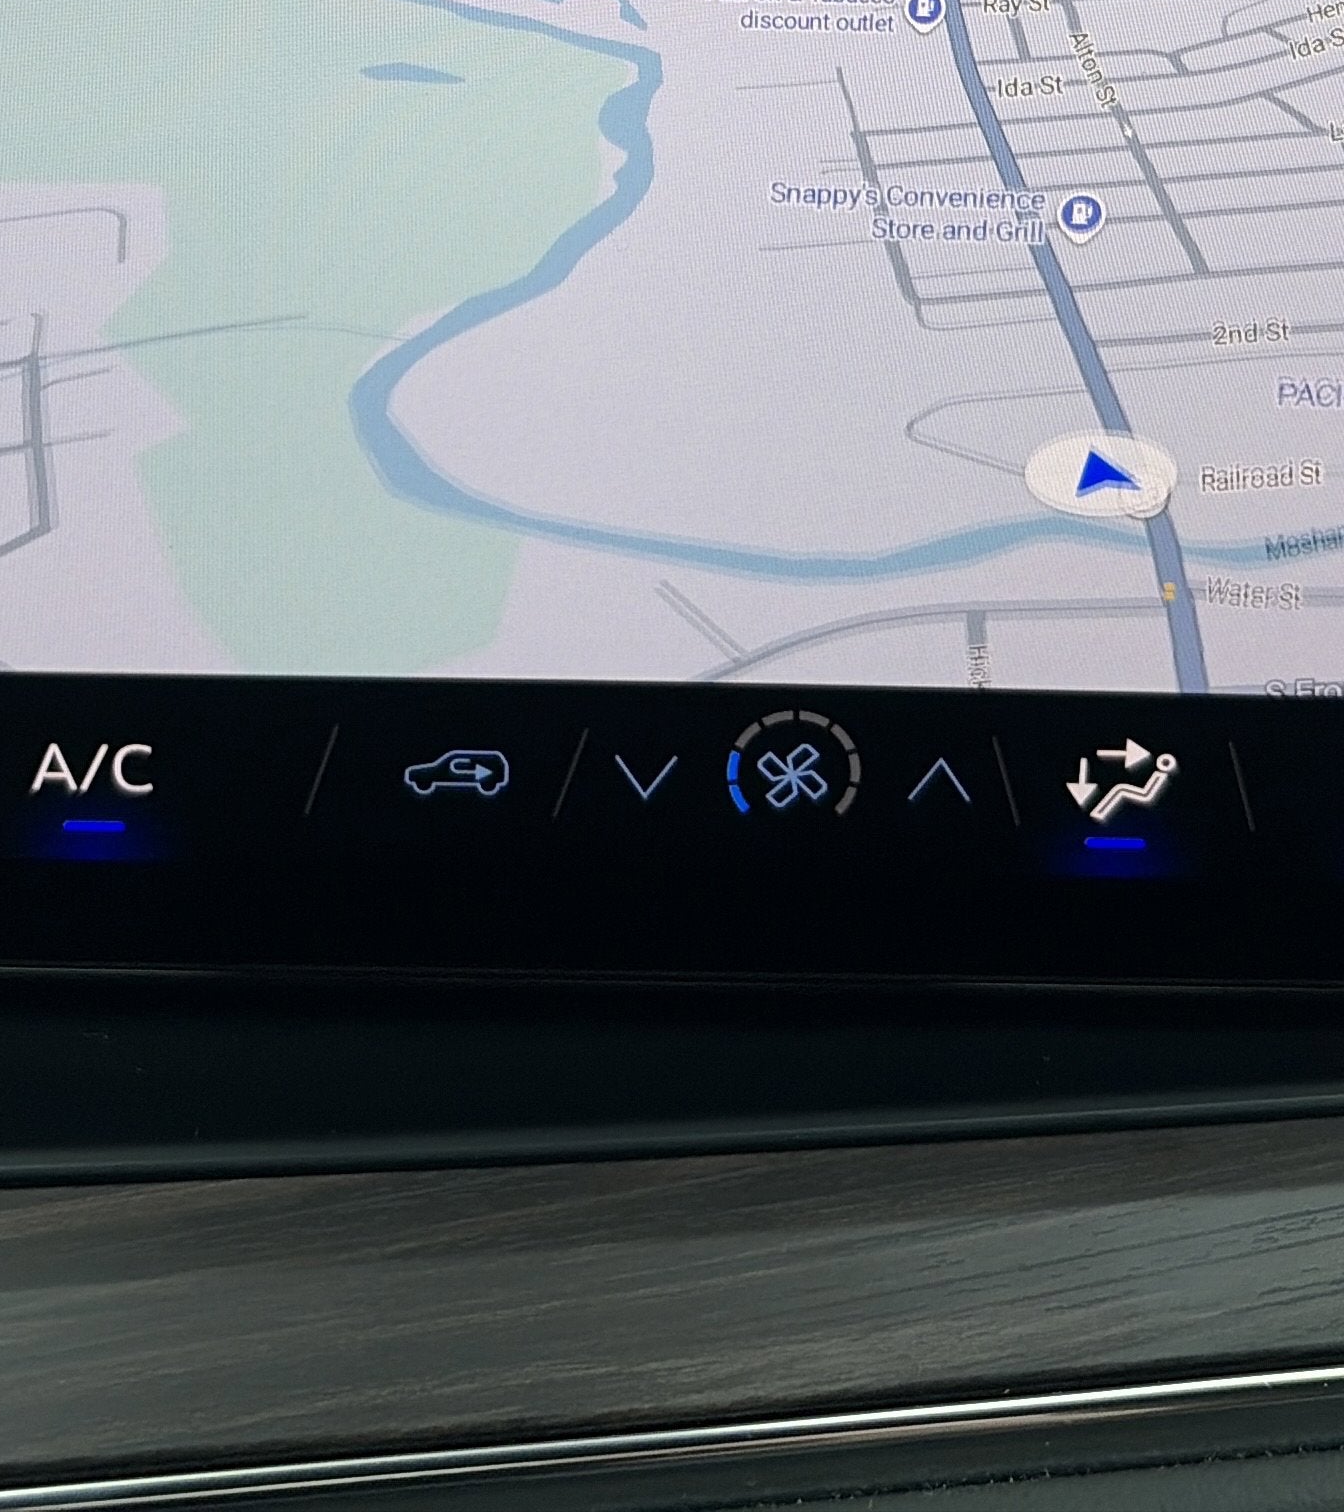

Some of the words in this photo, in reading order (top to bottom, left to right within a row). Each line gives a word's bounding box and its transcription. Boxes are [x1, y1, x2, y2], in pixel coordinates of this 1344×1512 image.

[739, 11, 831, 33] discount
[835, 13, 895, 34] outlet
[1288, 36, 1322, 62] Ida
[1069, 31, 1105, 88] Alton
[1093, 80, 1119, 109] St
[997, 78, 1033, 98] Ida
[1037, 75, 1064, 96] St
[769, 181, 879, 210] Snappy's
[885, 185, 1046, 212] Convenience
[871, 218, 935, 240] Store
[941, 219, 988, 241] and
[995, 219, 1046, 244] Grill
[1212, 322, 1257, 346] 2nd
[1261, 321, 1291, 344] St
[1201, 461, 1290, 494] Railroad
[1292, 458, 1324, 489] St
[1206, 575, 1273, 611] Water
[29, 740, 155, 796] A/C
